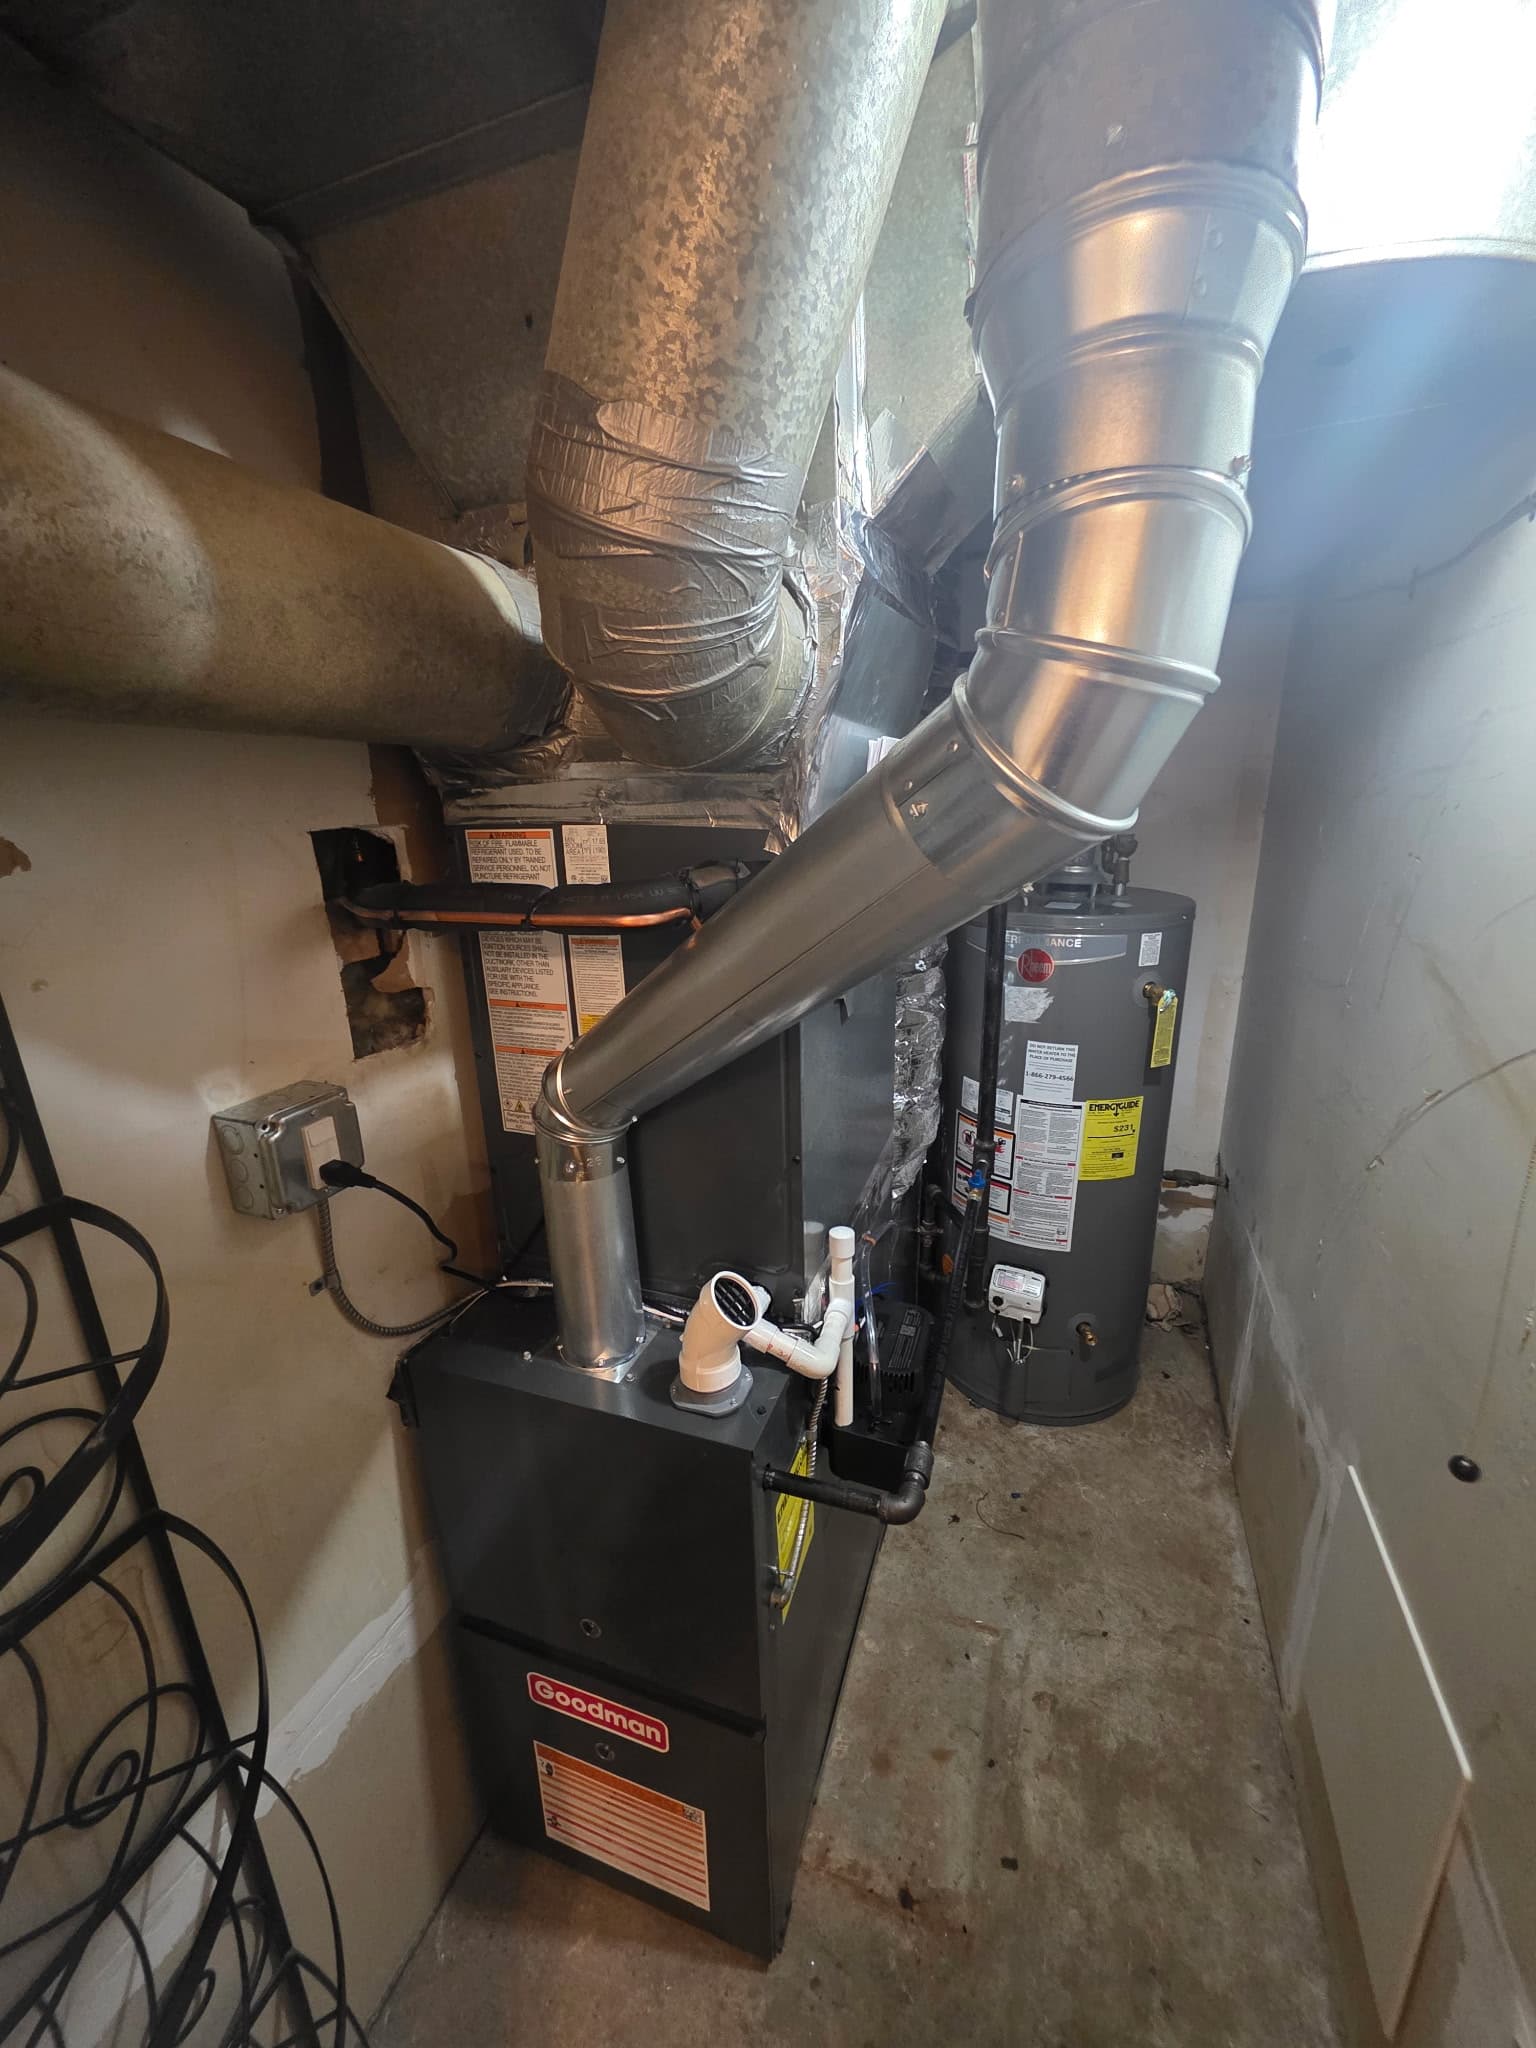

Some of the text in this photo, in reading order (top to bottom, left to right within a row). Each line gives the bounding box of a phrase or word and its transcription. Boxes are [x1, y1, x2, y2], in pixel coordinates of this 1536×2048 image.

[471, 848, 507, 856] REFRIGERANT
[512, 967, 535, 975] DEVICES
[1021, 950, 1051, 977] Rheem
[535, 1680, 662, 1742] Goodman
